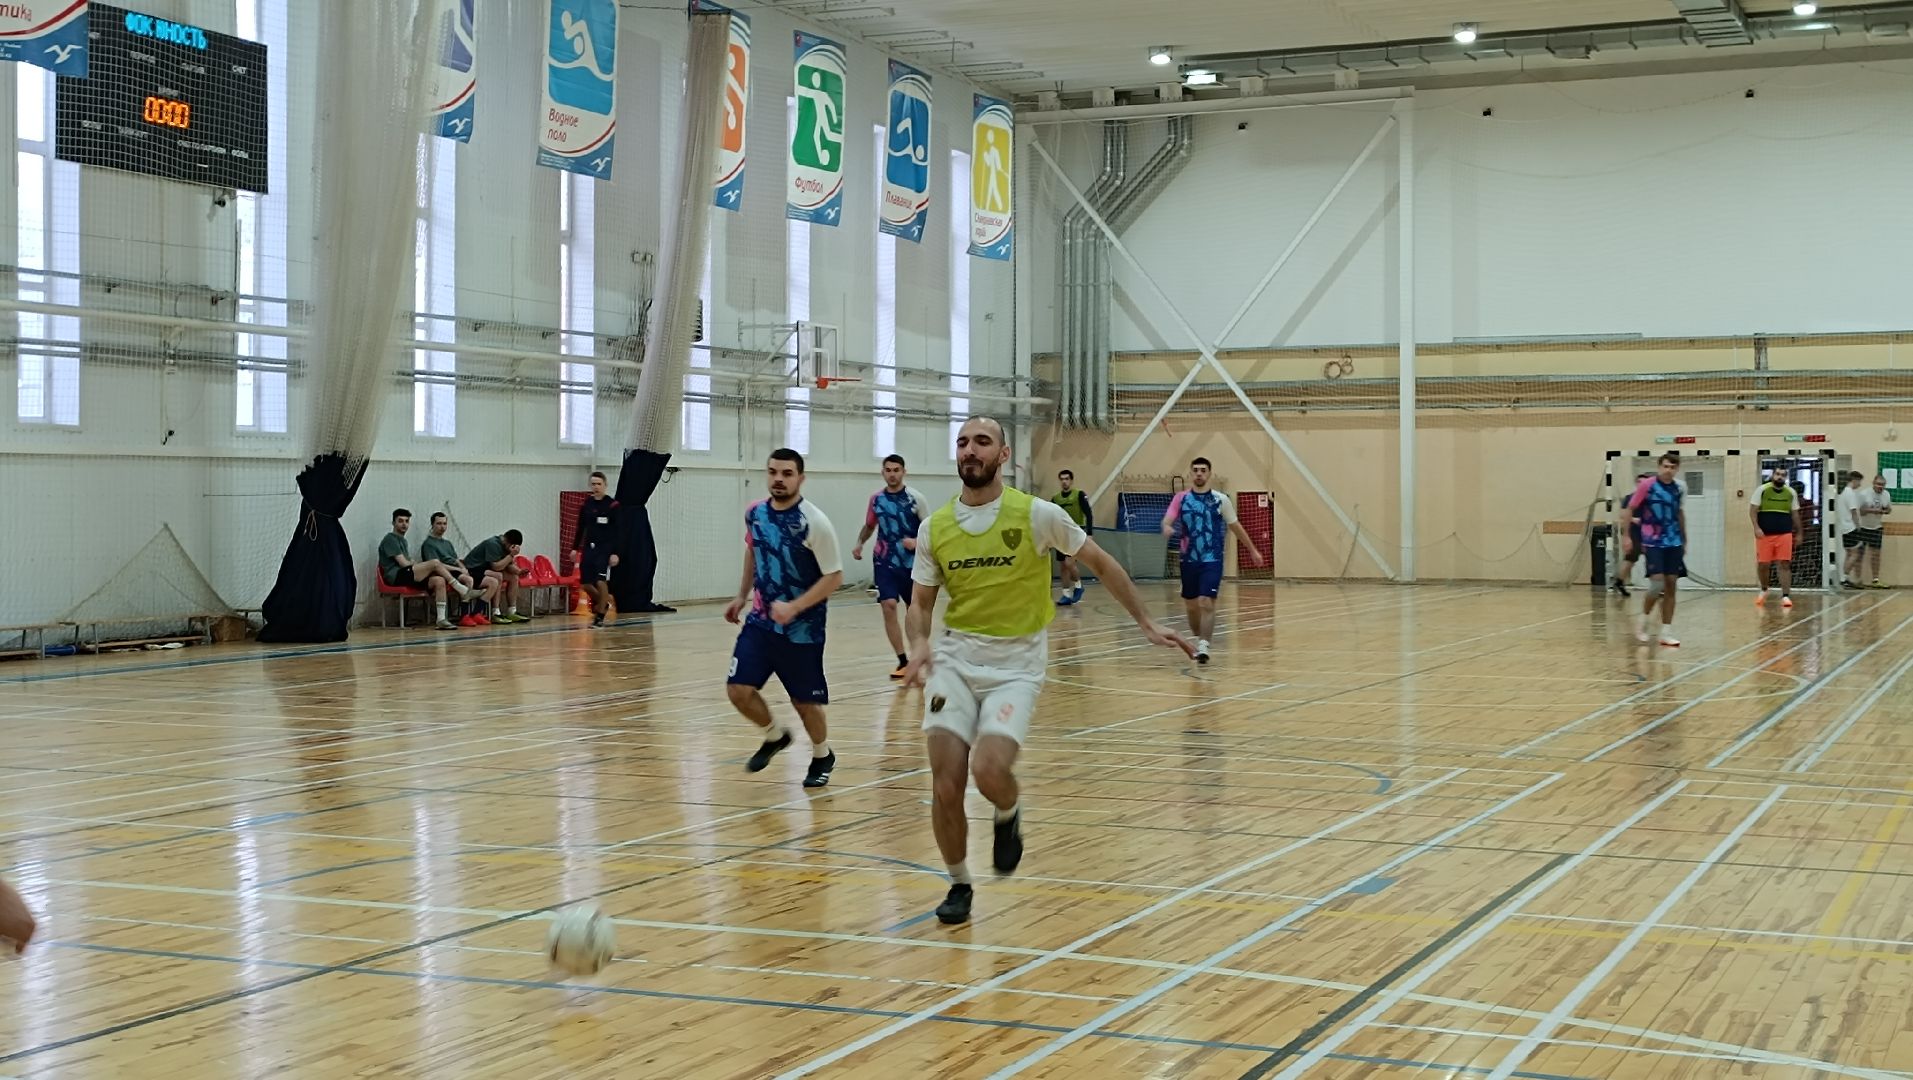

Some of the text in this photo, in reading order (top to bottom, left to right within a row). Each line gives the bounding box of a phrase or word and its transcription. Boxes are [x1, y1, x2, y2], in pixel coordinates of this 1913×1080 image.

[549, 108, 579, 127] Водное
[548, 129, 567, 142] поло
[795, 176, 823, 193] Футбол
[948, 555, 1016, 570] DEMIX
